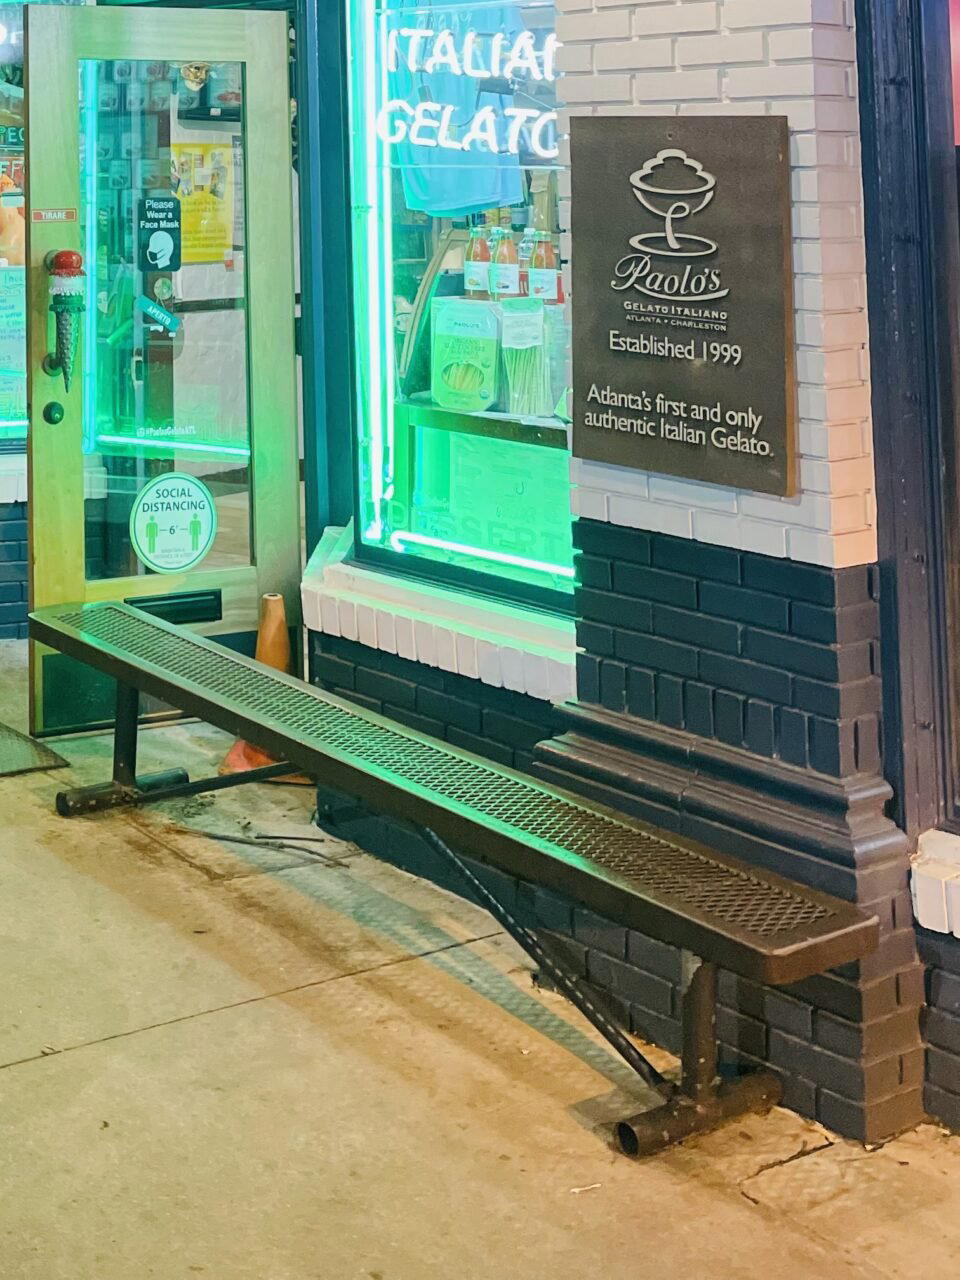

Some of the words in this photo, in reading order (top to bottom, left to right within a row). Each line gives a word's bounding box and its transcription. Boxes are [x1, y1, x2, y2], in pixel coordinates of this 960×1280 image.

[145, 199, 174, 209] Please
[146, 210, 166, 219] Wear
[140, 220, 158, 229] Face
[160, 220, 180, 229] Mask
[610, 253, 730, 301] Paolo's
[146, 304, 172, 326] APERTO
[623, 300, 669, 314] GELATO
[671, 305, 728, 320] ITALIANO
[625, 313, 662, 324] ATLANTA
[670, 319, 727, 332] CHARLESTON
[609, 329, 695, 361] Established
[702, 340, 742, 366] 1999
[587, 383, 652, 412] Atlanta's
[655, 393, 687, 418] first
[690, 402, 721, 423] and
[725, 407, 763, 435] only
[584, 409, 656, 437] authentic
[660, 417, 706, 446] Italian
[711, 426, 775, 458] Gelato.
[155, 487, 192, 499] SOCIAL
[142, 500, 206, 513] DISTANCING
